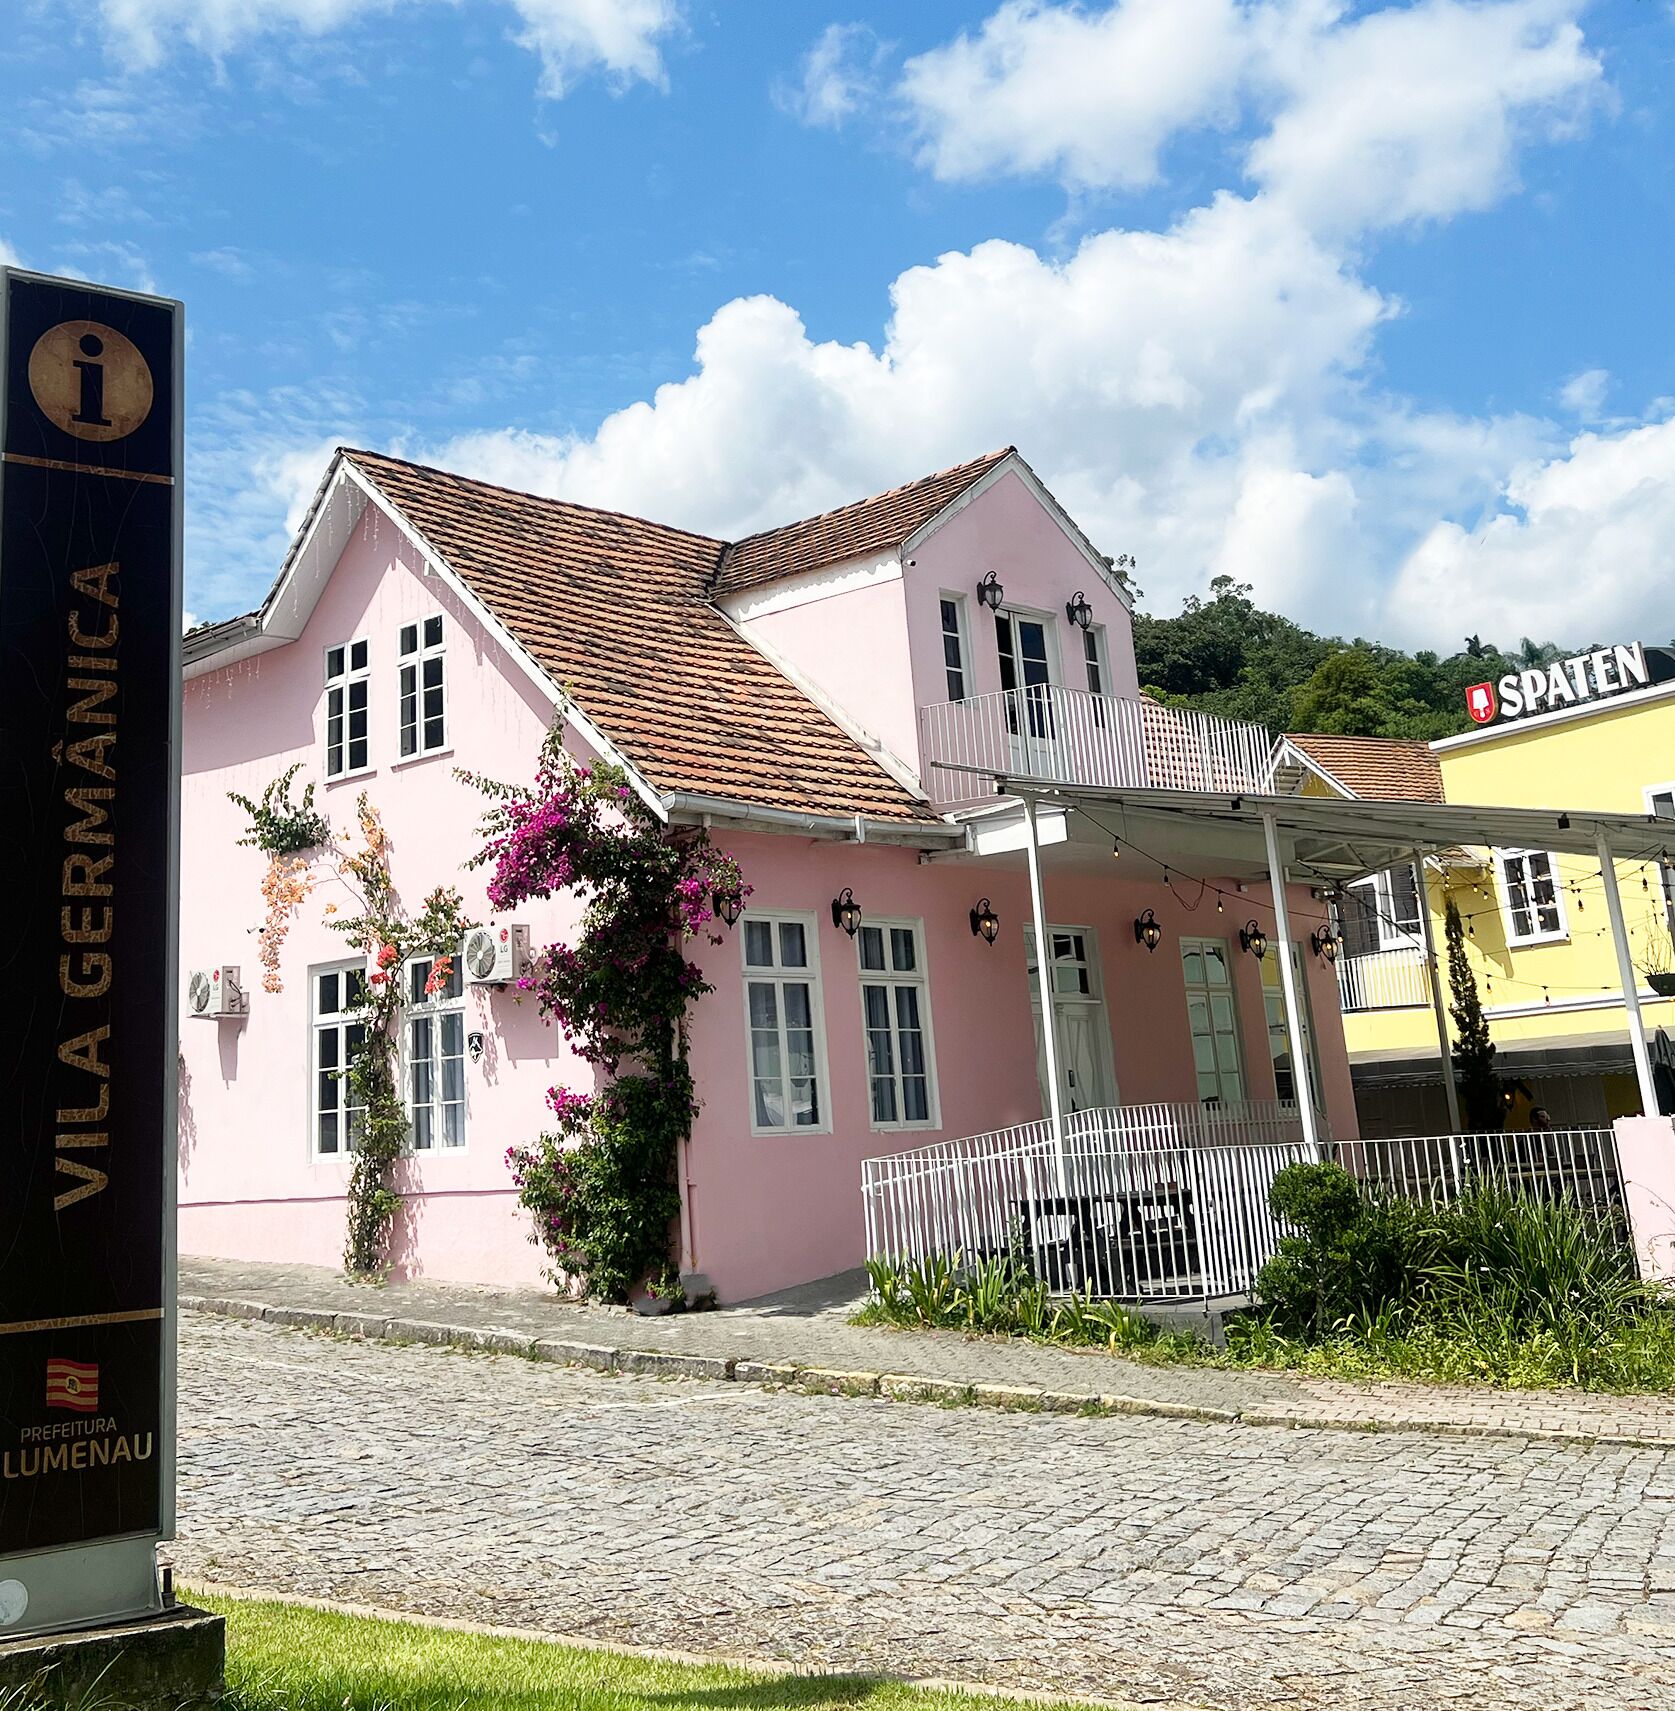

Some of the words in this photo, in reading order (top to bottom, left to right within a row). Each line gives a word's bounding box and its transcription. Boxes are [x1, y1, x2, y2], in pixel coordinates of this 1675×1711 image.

[1499, 640, 1649, 717] SPATEN
[51, 562, 120, 998] GERMÂNICA
[500, 944, 508, 953] LG
[54, 1024, 110, 1211] VILA
[20, 1416, 118, 1443] PREFEITURA
